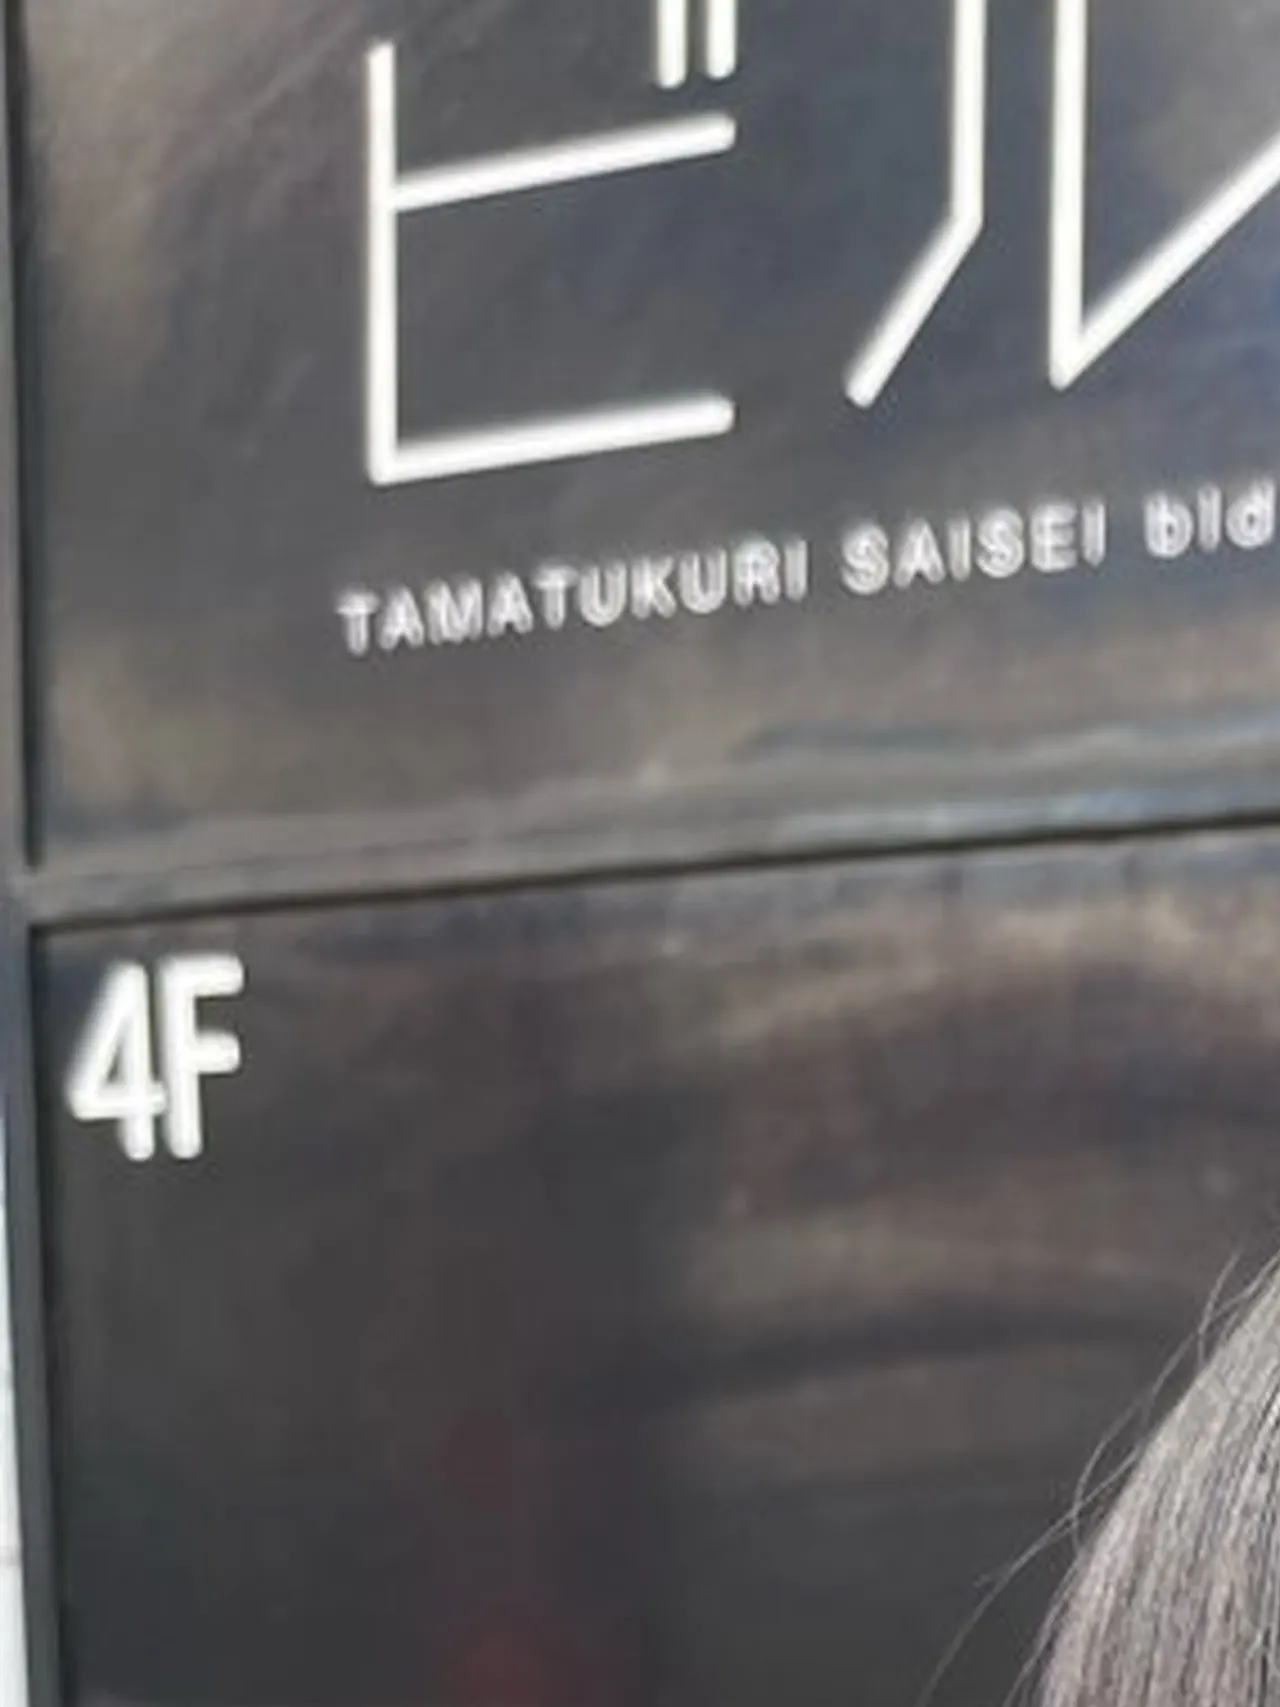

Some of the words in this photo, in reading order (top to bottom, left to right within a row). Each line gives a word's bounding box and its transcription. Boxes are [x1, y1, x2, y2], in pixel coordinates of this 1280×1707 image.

[337, 536, 808, 656] TAMATUKURI
[840, 497, 1107, 596] SAISEI
[66, 952, 245, 1162] 4F
